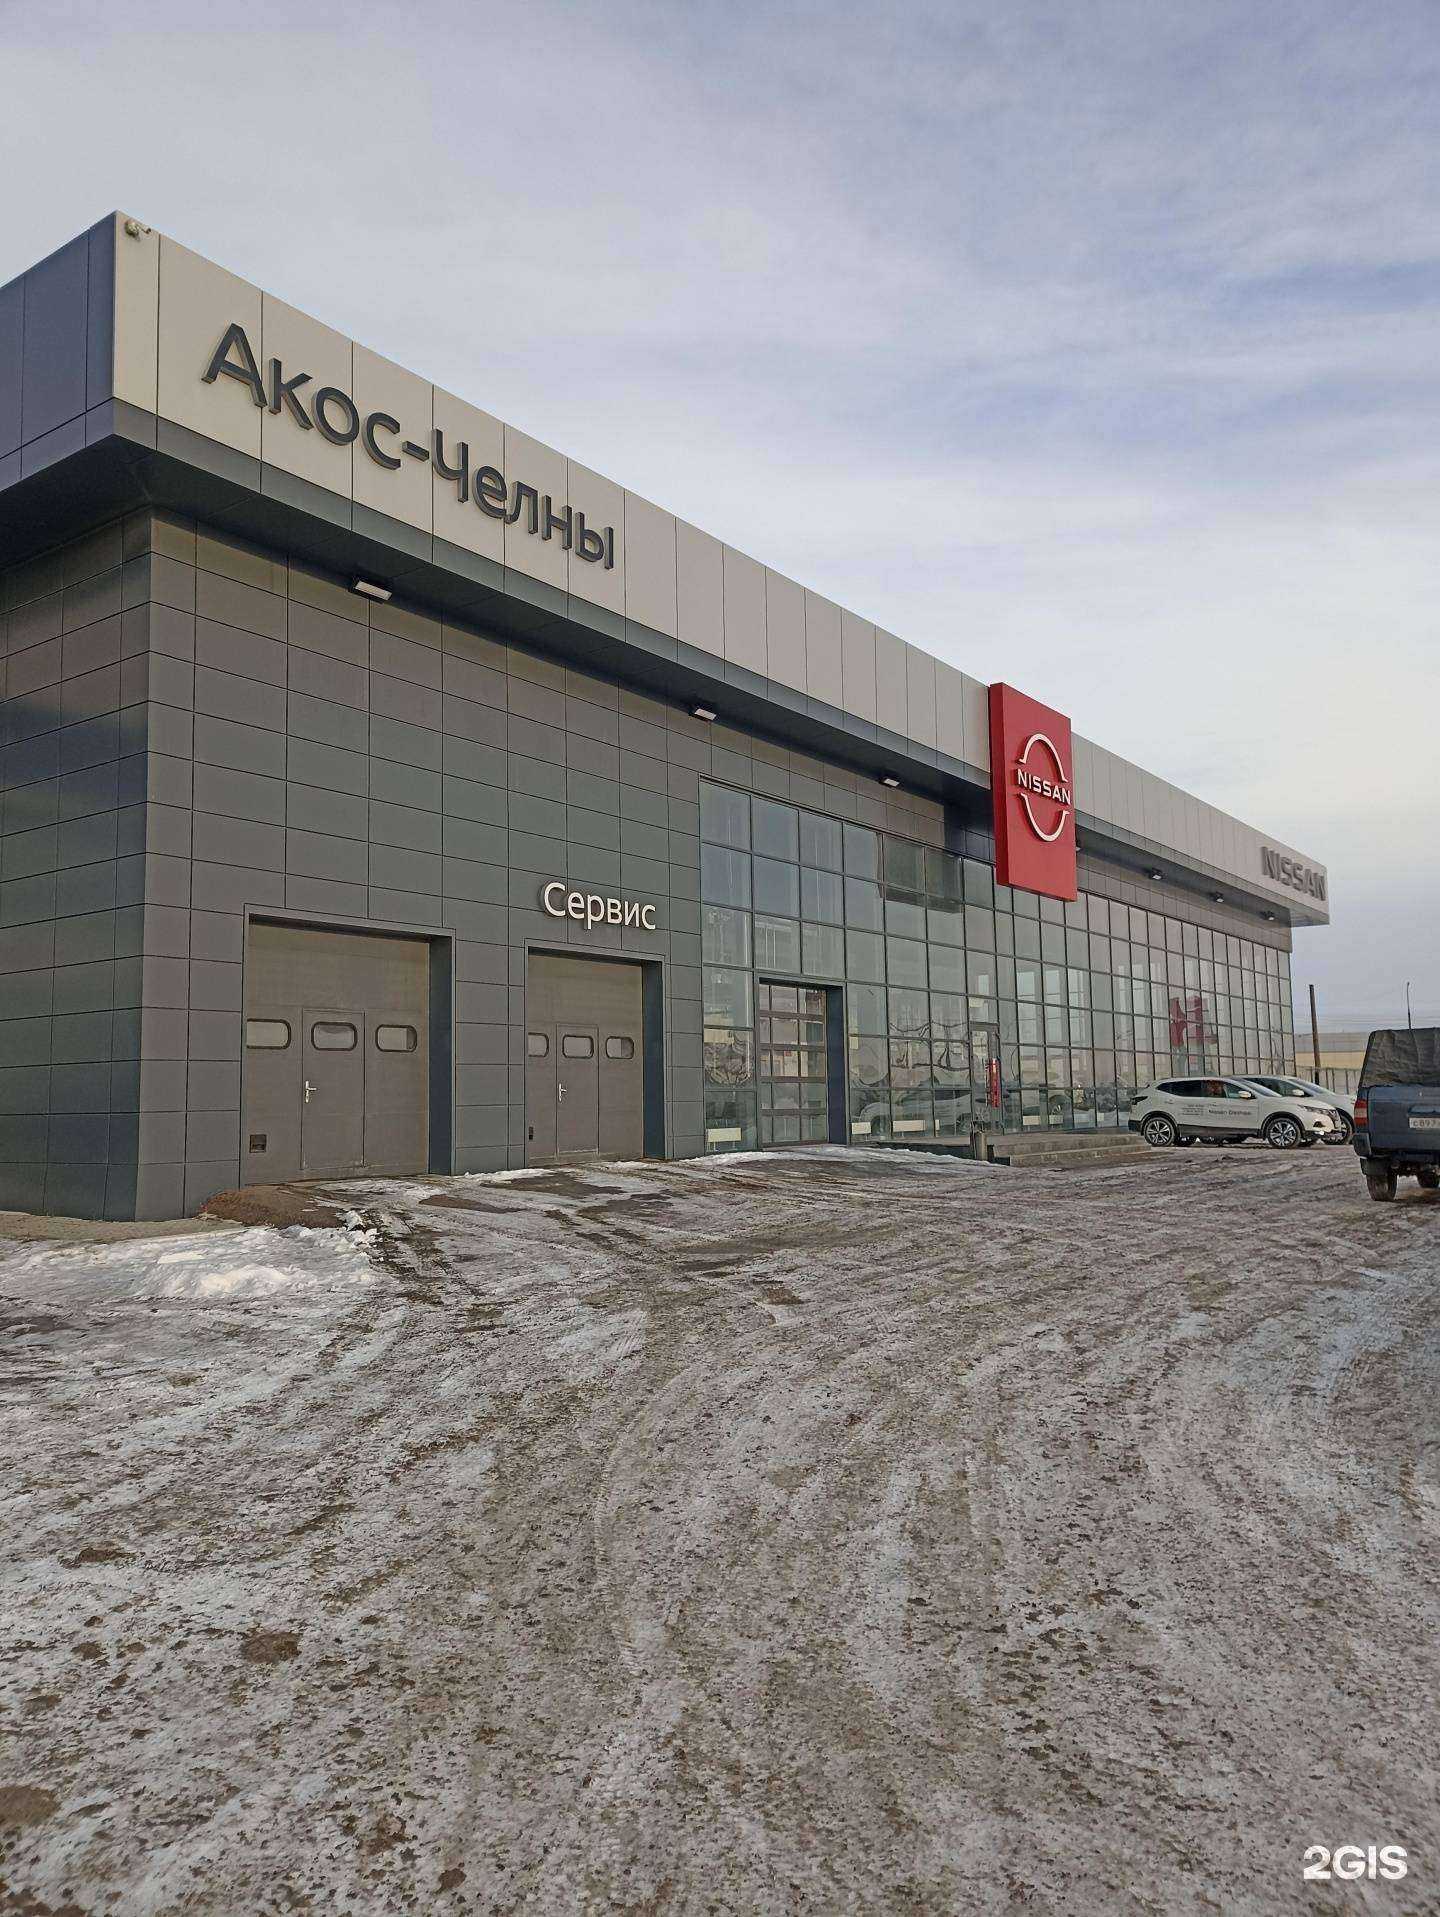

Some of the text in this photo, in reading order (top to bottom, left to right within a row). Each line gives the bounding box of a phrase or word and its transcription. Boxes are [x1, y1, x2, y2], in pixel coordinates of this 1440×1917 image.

[201, 322, 615, 570] Акос-Челны
[1017, 768, 1071, 805] NISSAN
[1260, 846, 1326, 901] NISSAN
[542, 881, 657, 931] Сервис
